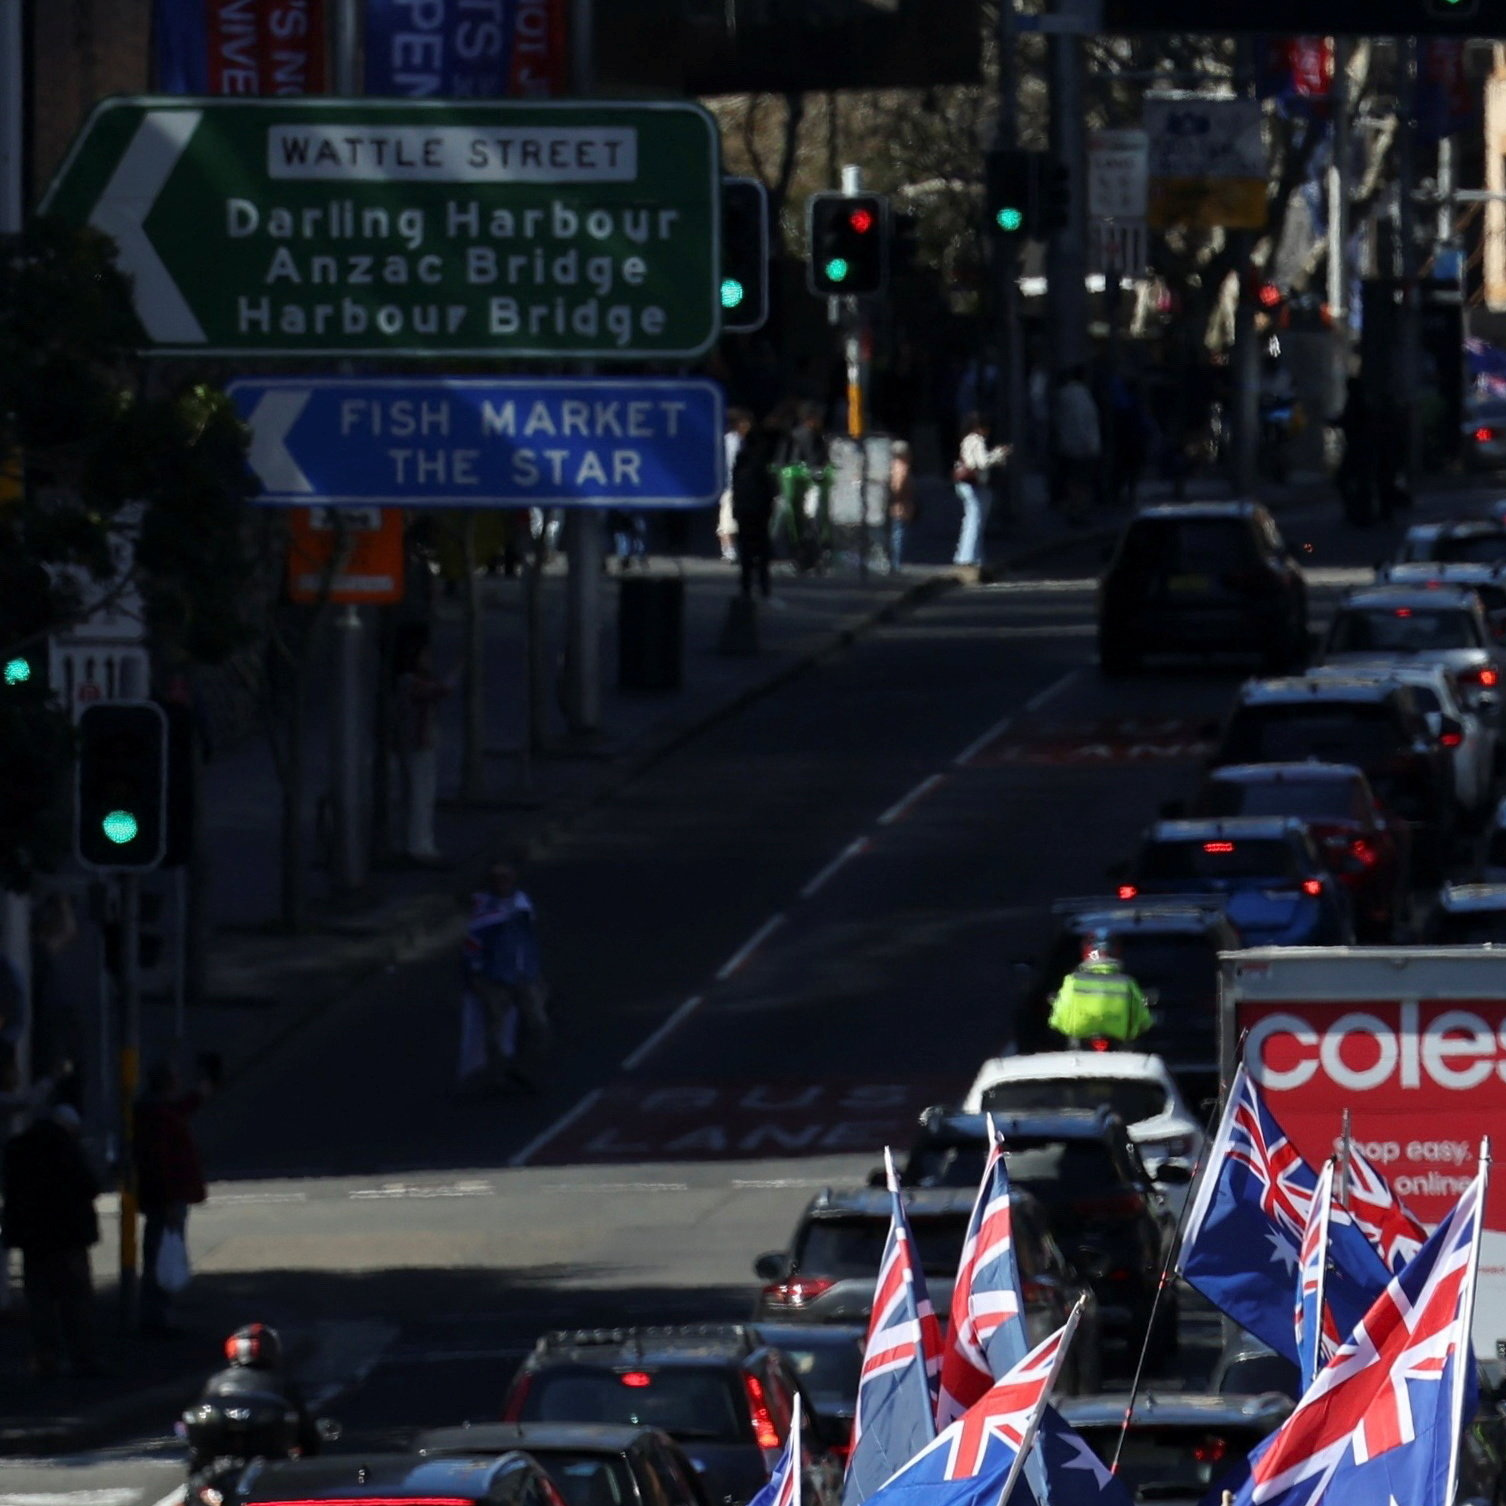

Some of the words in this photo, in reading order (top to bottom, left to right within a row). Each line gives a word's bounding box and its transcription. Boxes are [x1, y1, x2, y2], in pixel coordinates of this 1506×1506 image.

[282, 136, 444, 167] WATTLE
[468, 139, 624, 169] STREET
[226, 197, 424, 251] Darling
[446, 200, 680, 244] Harbour
[265, 246, 443, 285] Anzac
[466, 246, 648, 297] Bridge
[237, 296, 467, 335] Harbour
[489, 296, 667, 347] Bridge
[341, 399, 450, 437] FISH
[481, 400, 687, 438] MARKET
[388, 449, 480, 485] THE
[512, 449, 642, 486] STAR
